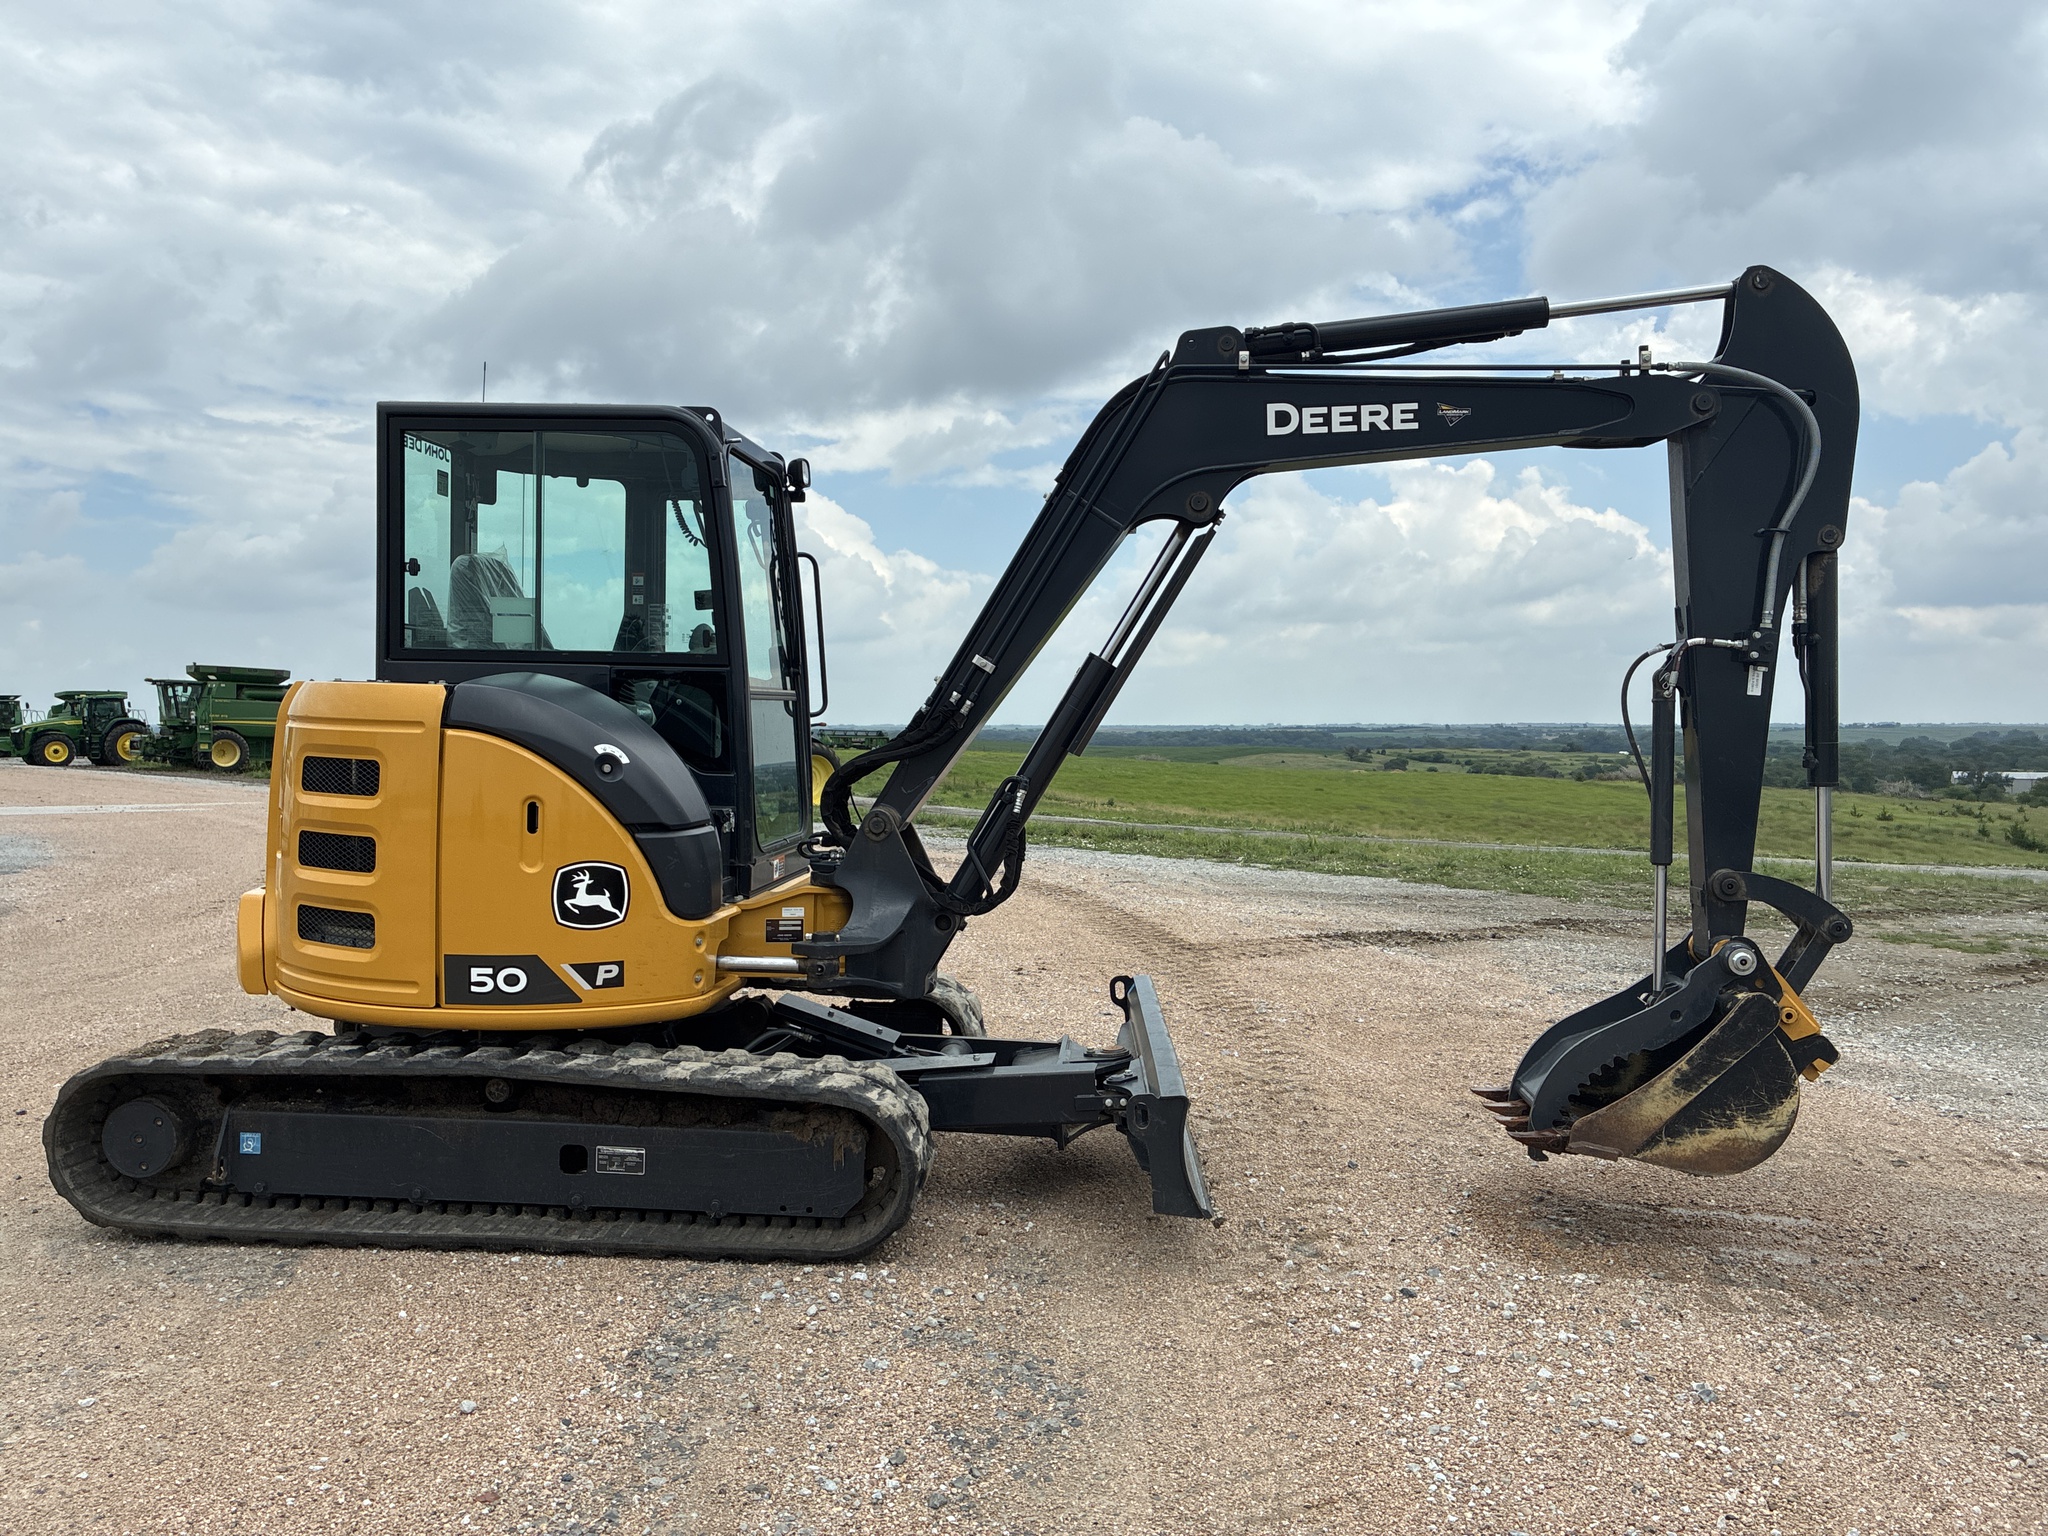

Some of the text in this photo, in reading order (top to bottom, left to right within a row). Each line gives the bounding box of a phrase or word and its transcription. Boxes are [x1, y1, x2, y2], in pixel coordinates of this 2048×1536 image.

[1266, 402, 1419, 436] DEERE
[470, 967, 528, 994] 50
[595, 964, 620, 986] P
